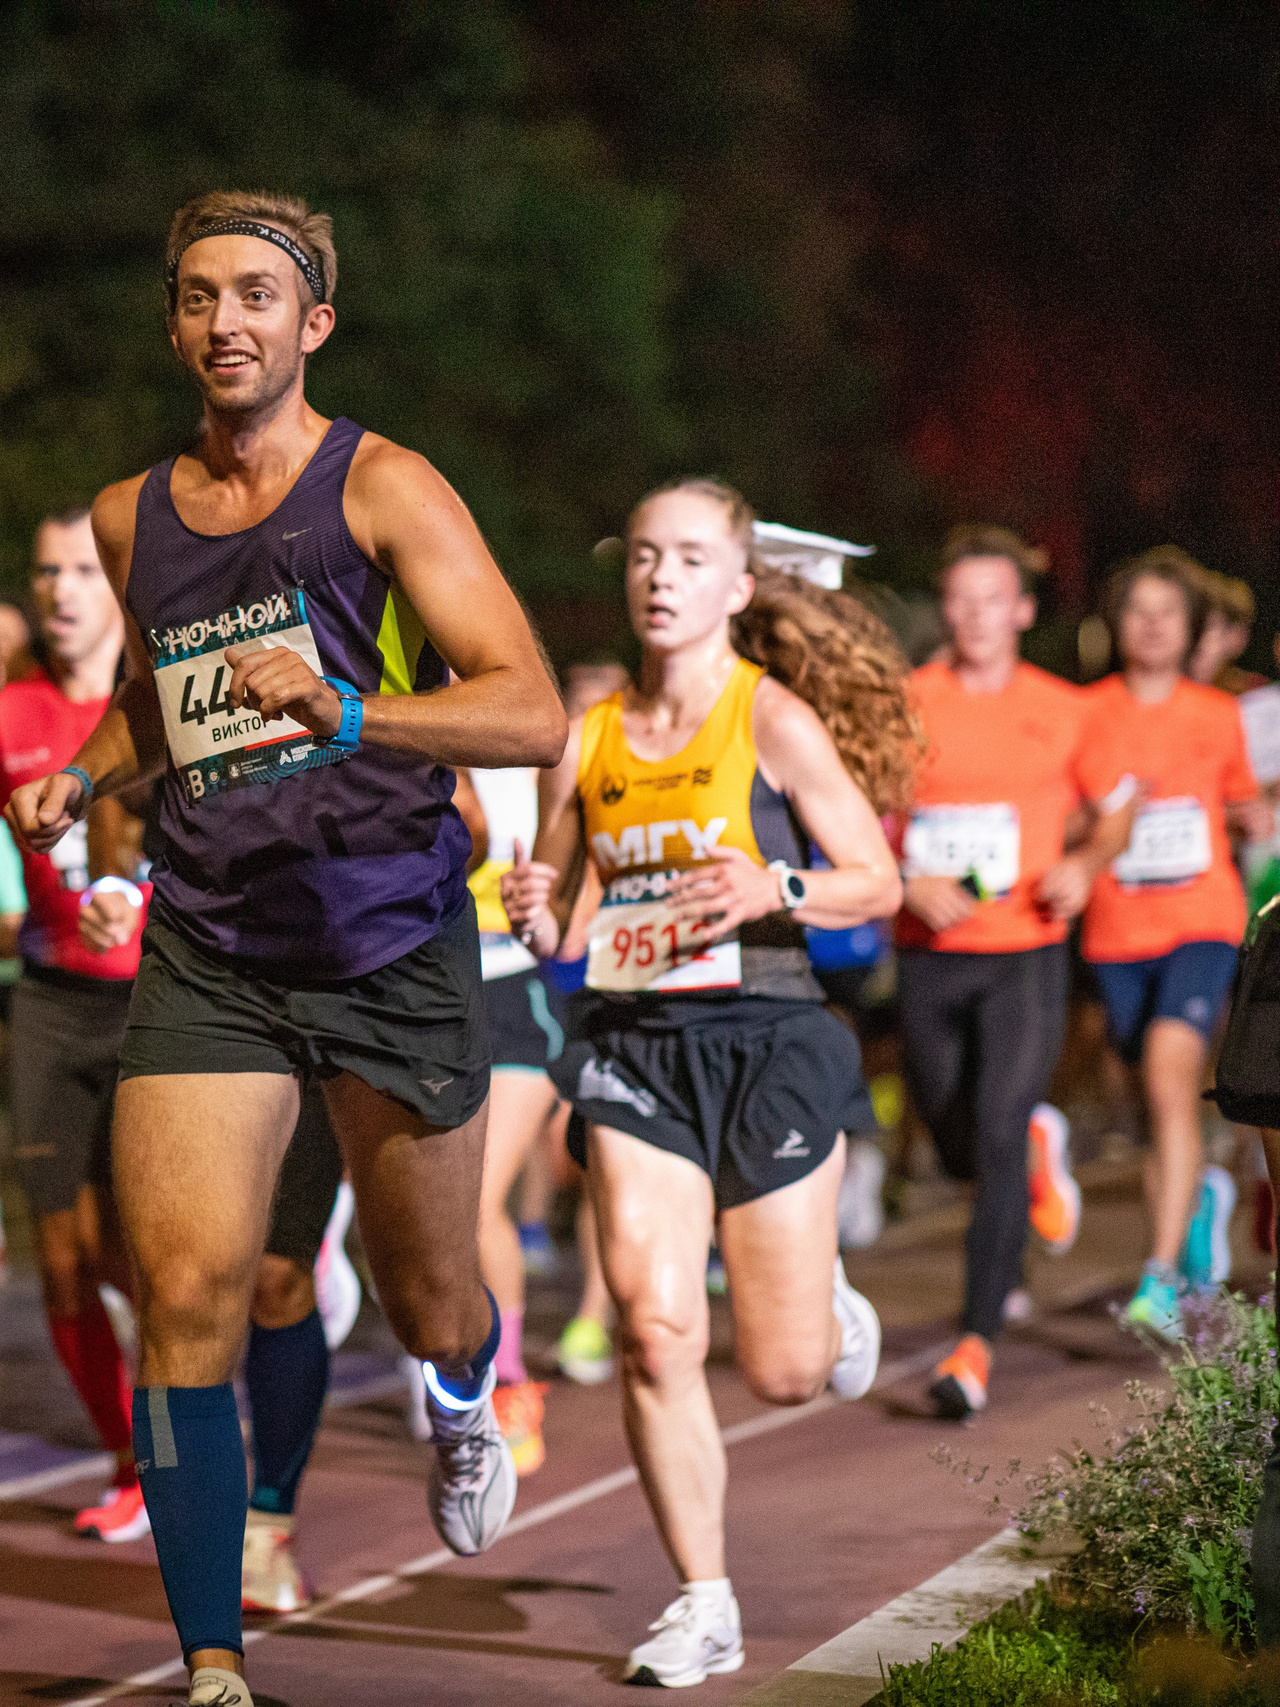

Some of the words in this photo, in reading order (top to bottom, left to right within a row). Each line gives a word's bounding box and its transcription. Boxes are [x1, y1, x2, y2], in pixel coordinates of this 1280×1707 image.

[271, 233, 309, 265] МАСТЕР
[165, 592, 291, 655] НОЧНОЙ
[180, 665, 257, 726] 44
[591, 817, 728, 868] МГУ
